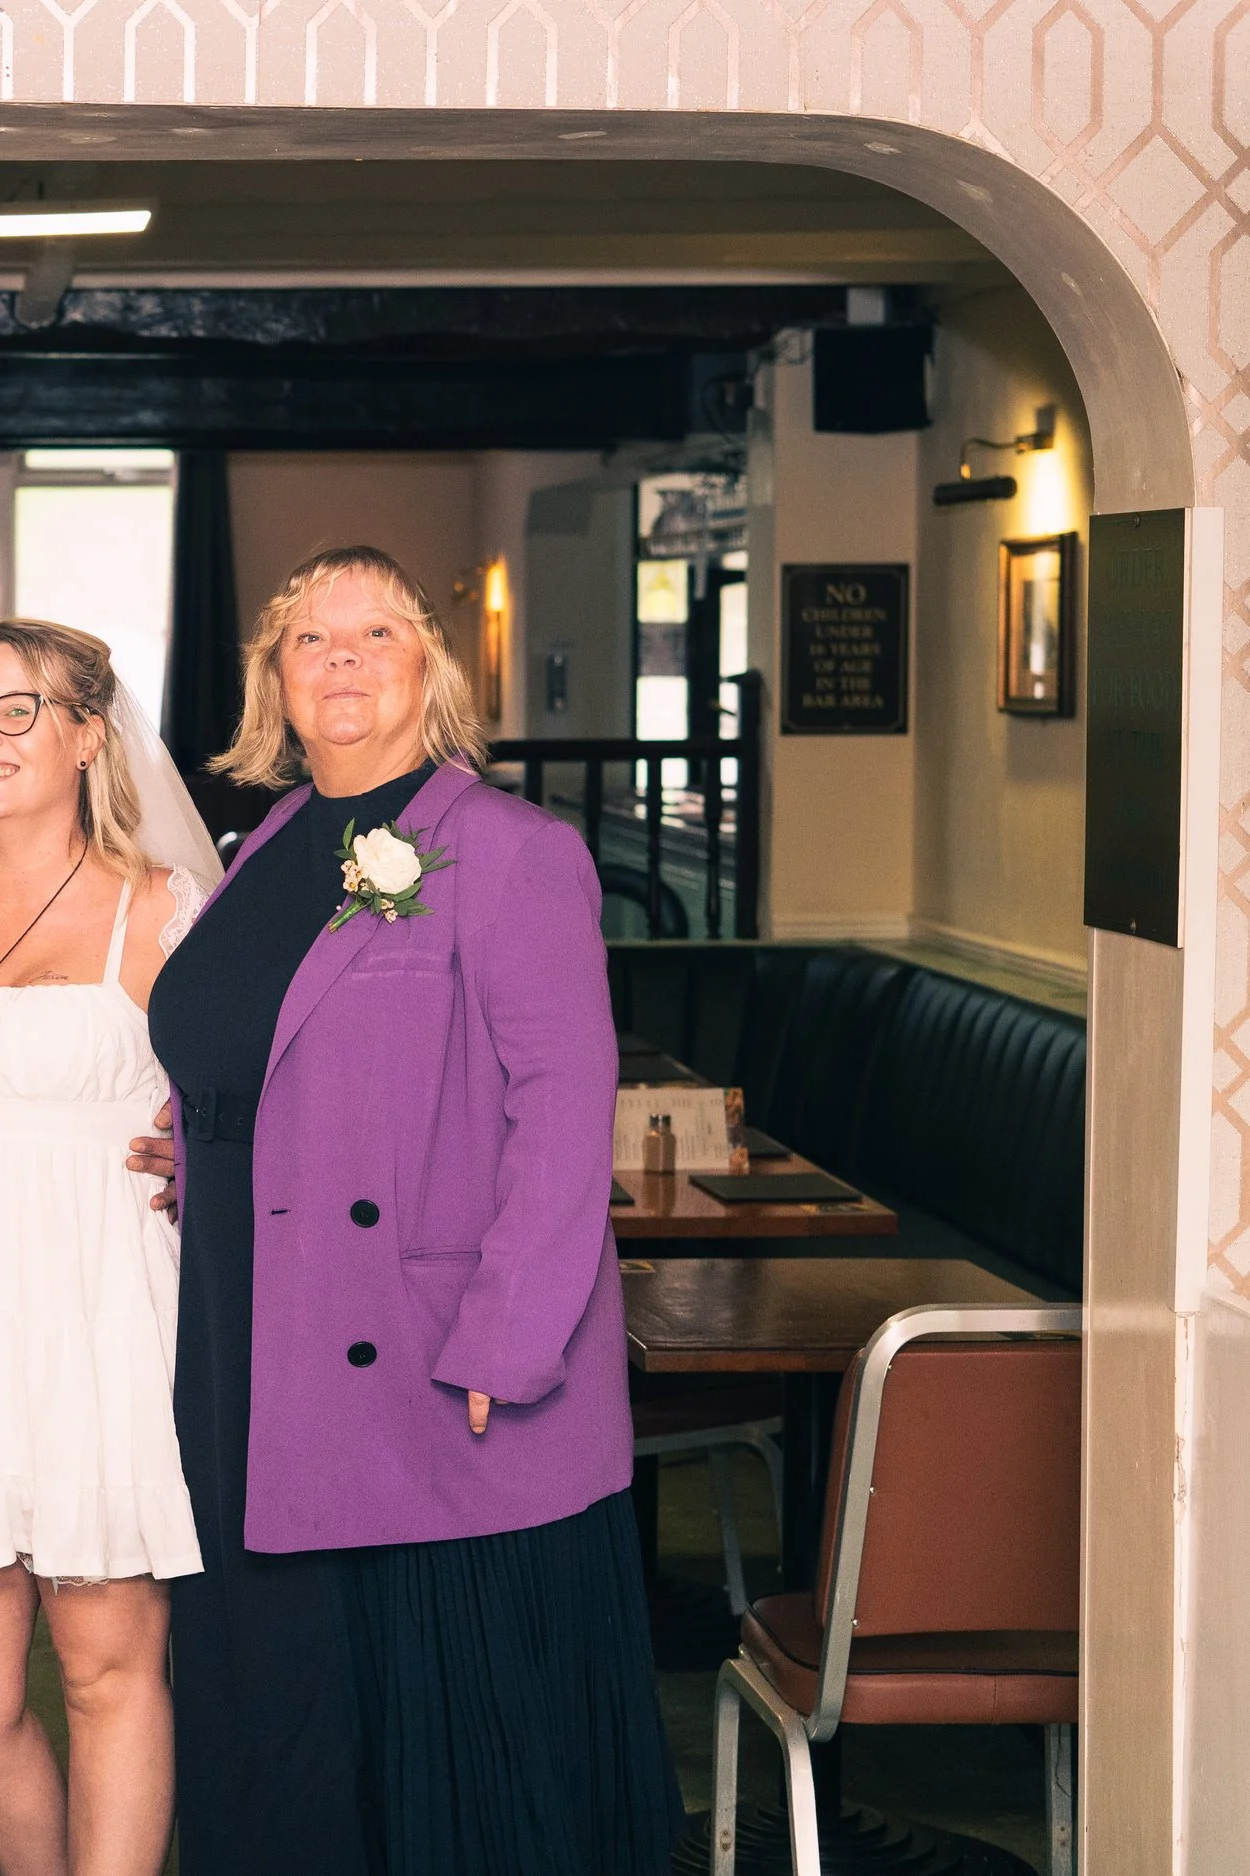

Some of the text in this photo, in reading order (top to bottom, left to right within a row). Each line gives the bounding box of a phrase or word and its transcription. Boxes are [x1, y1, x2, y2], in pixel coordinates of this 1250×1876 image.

[825, 582, 867, 605] NO
[801, 607, 887, 622] CHILDREN
[815, 624, 873, 639] UNDER
[830, 642, 882, 657] YEARS
[814, 660, 872, 674] OF AGE
[815, 676, 871, 691] IN THE
[802, 693, 884, 708] BAR AREA
